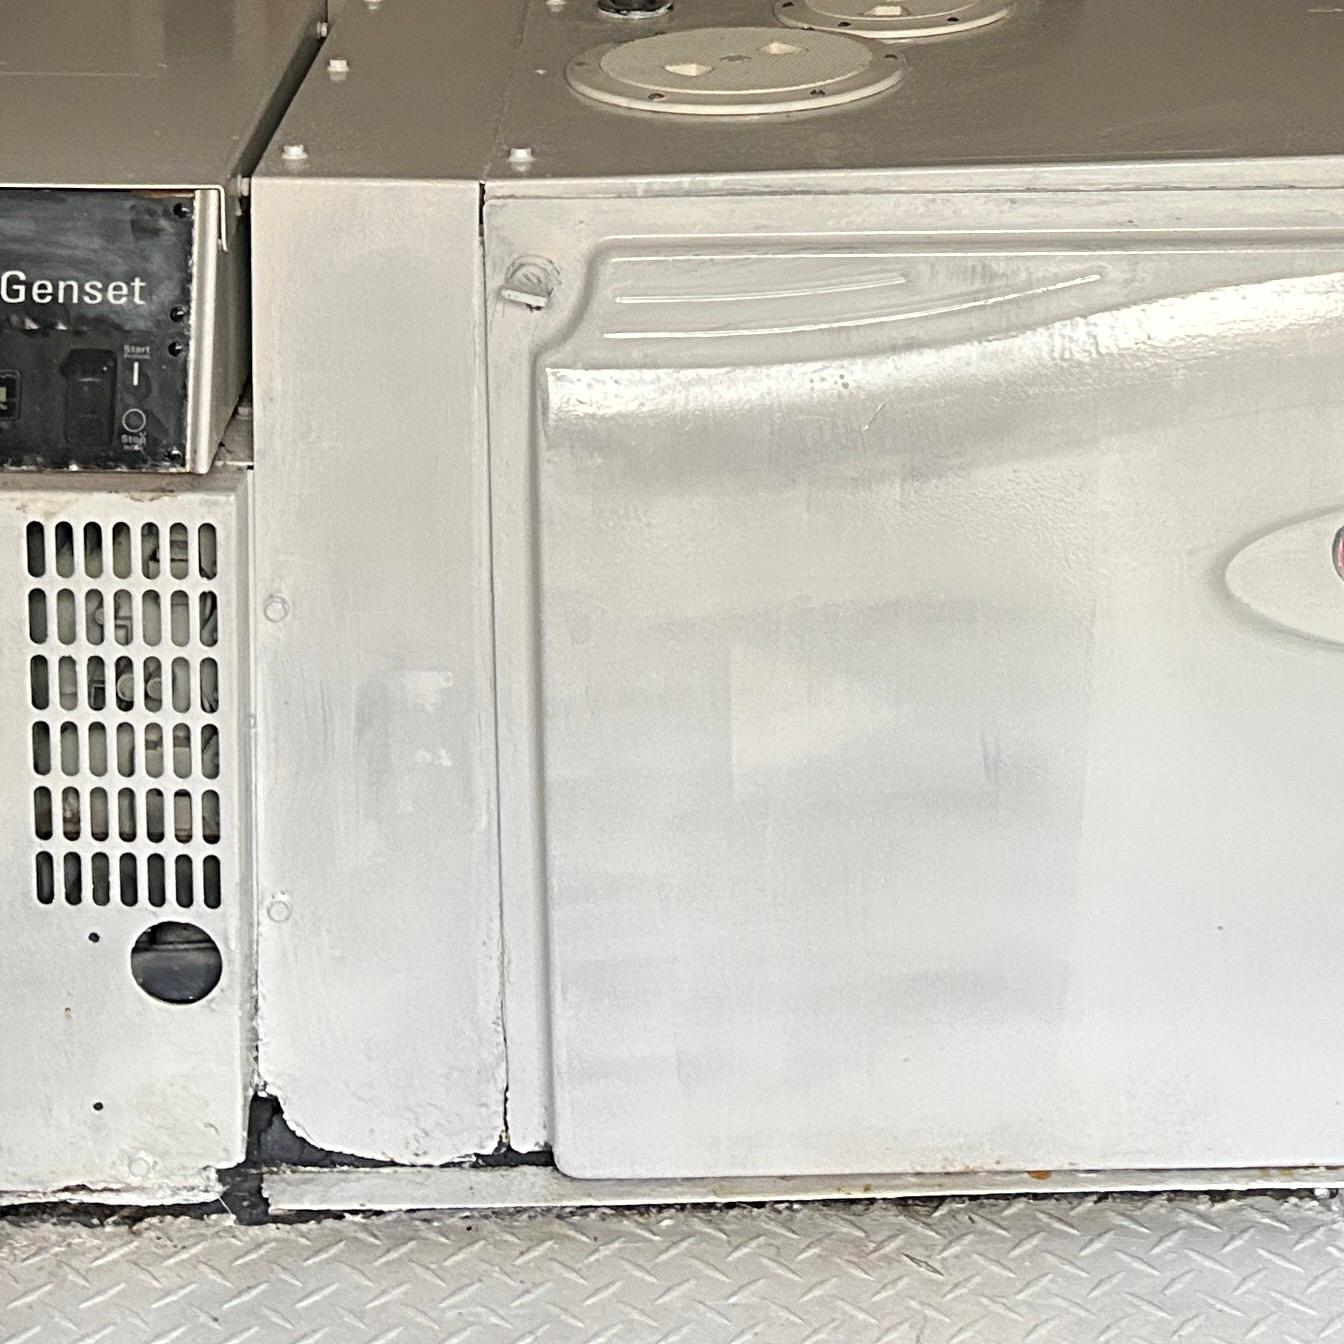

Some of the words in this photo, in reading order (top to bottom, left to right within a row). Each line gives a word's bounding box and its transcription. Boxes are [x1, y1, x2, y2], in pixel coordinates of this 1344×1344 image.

[0, 270, 147, 307] Genset
[123, 344, 151, 354] Start
[121, 434, 147, 446] Stop
